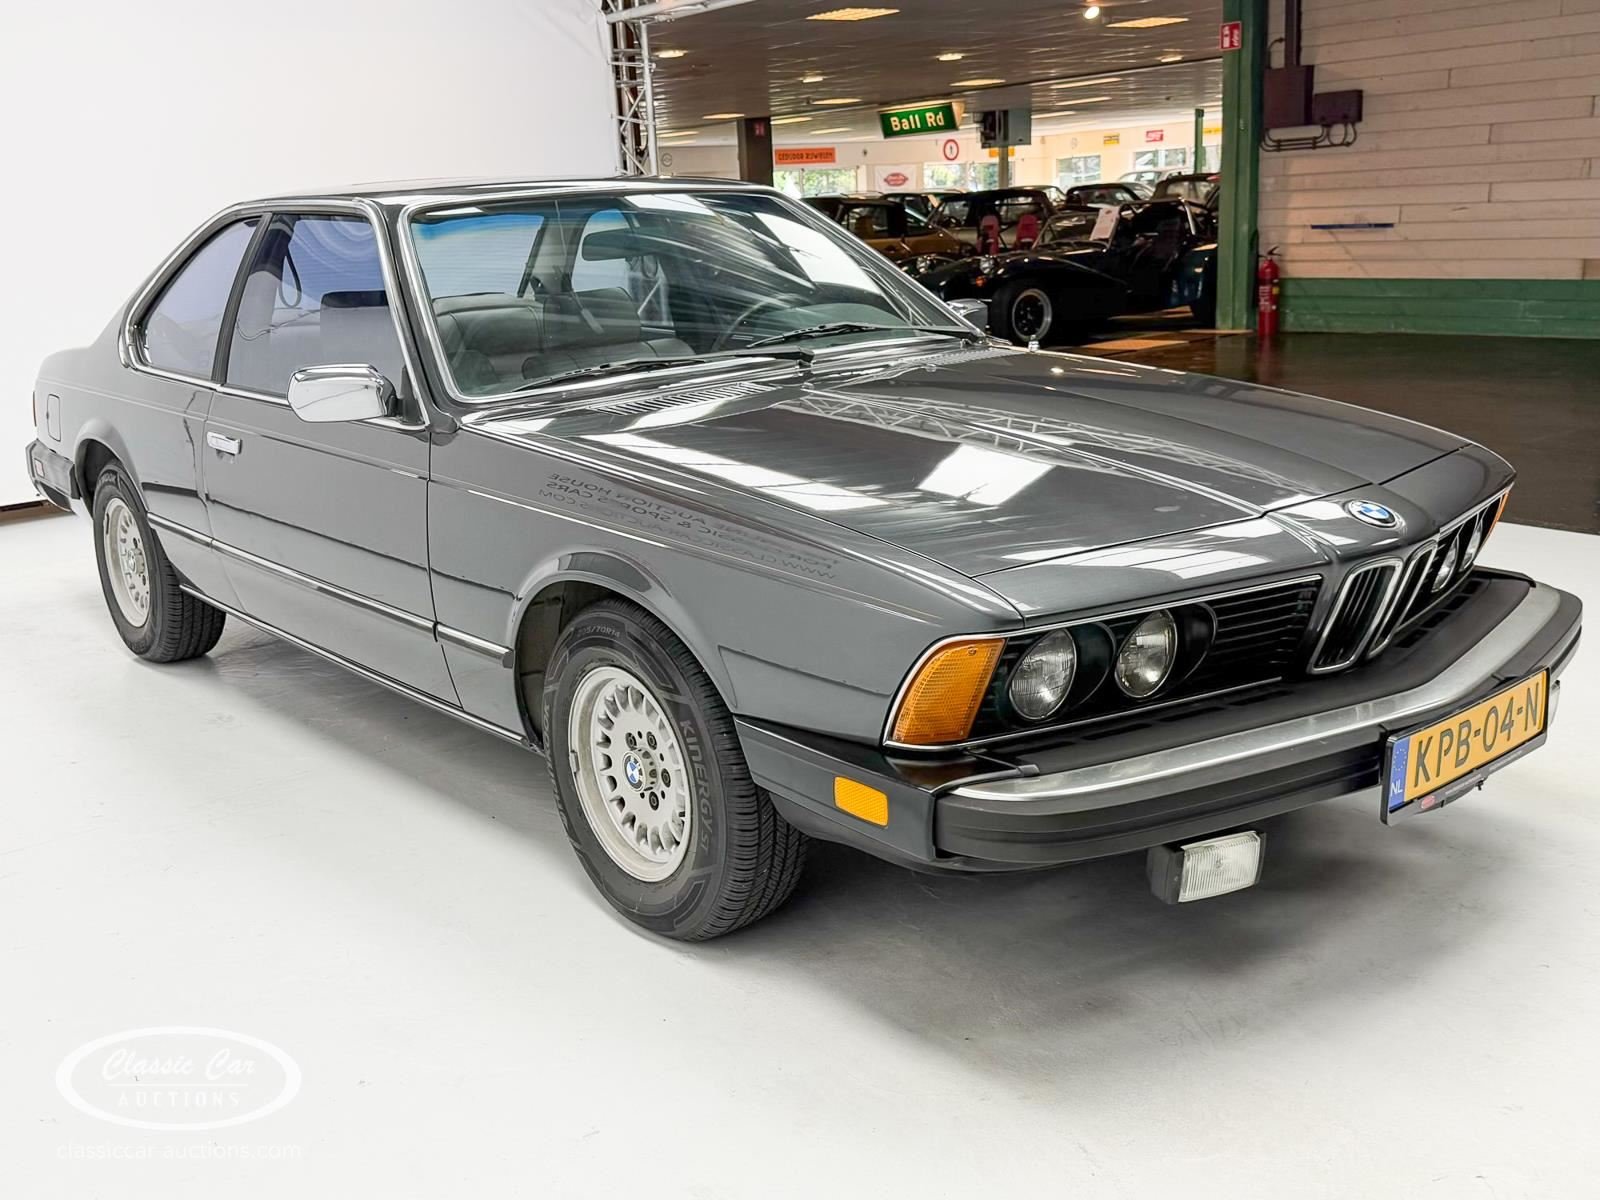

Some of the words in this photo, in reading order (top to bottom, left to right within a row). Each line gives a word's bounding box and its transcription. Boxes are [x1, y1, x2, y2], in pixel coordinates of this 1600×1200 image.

[890, 114, 921, 131] Ball
[925, 112, 945, 127] Rd
[1413, 682, 1540, 788] KPB-04-N
[680, 720, 713, 833] KINERGY
[1390, 780, 1403, 796] NL
